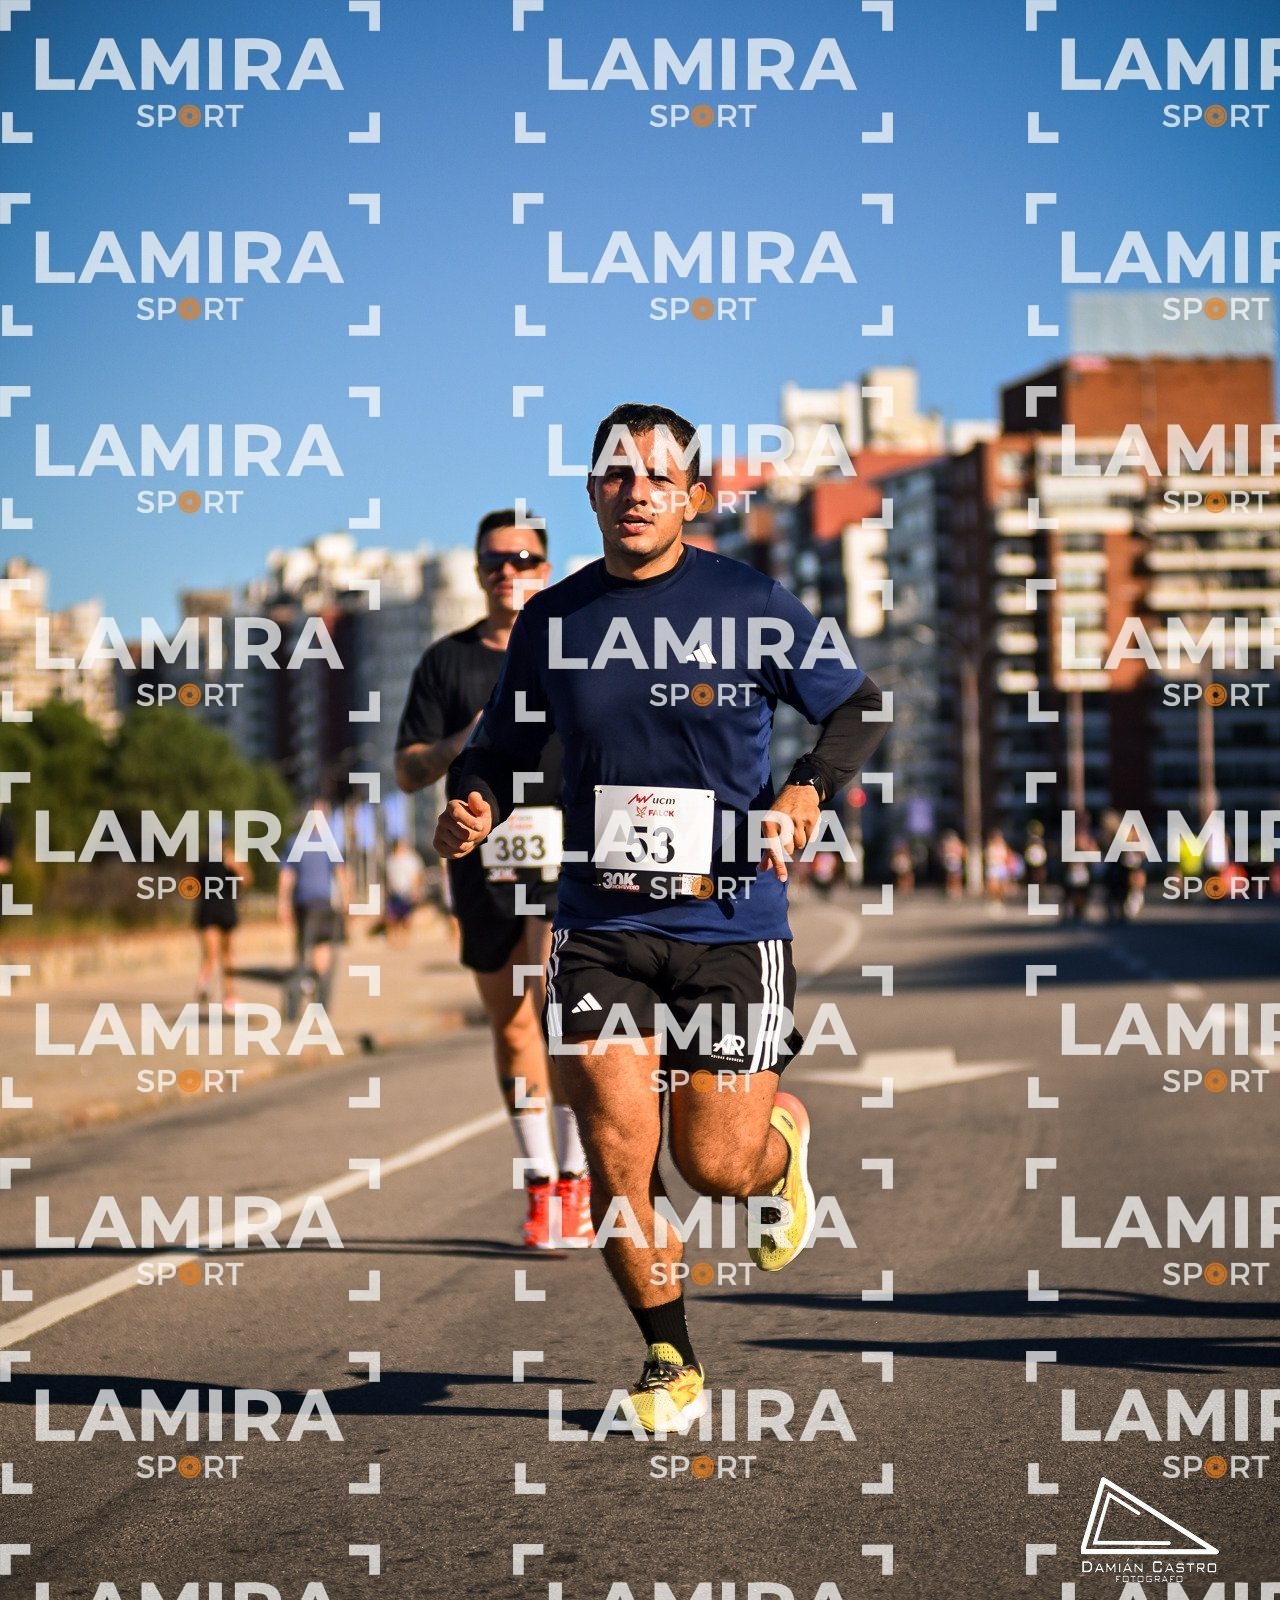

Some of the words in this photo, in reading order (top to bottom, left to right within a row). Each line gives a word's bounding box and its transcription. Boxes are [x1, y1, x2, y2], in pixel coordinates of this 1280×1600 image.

[652, 797, 676, 805] ucm
[648, 809, 675, 817] FALCK
[495, 835, 546, 861] 383
[625, 826, 675, 863] 53
[603, 872, 637, 889] 30K
